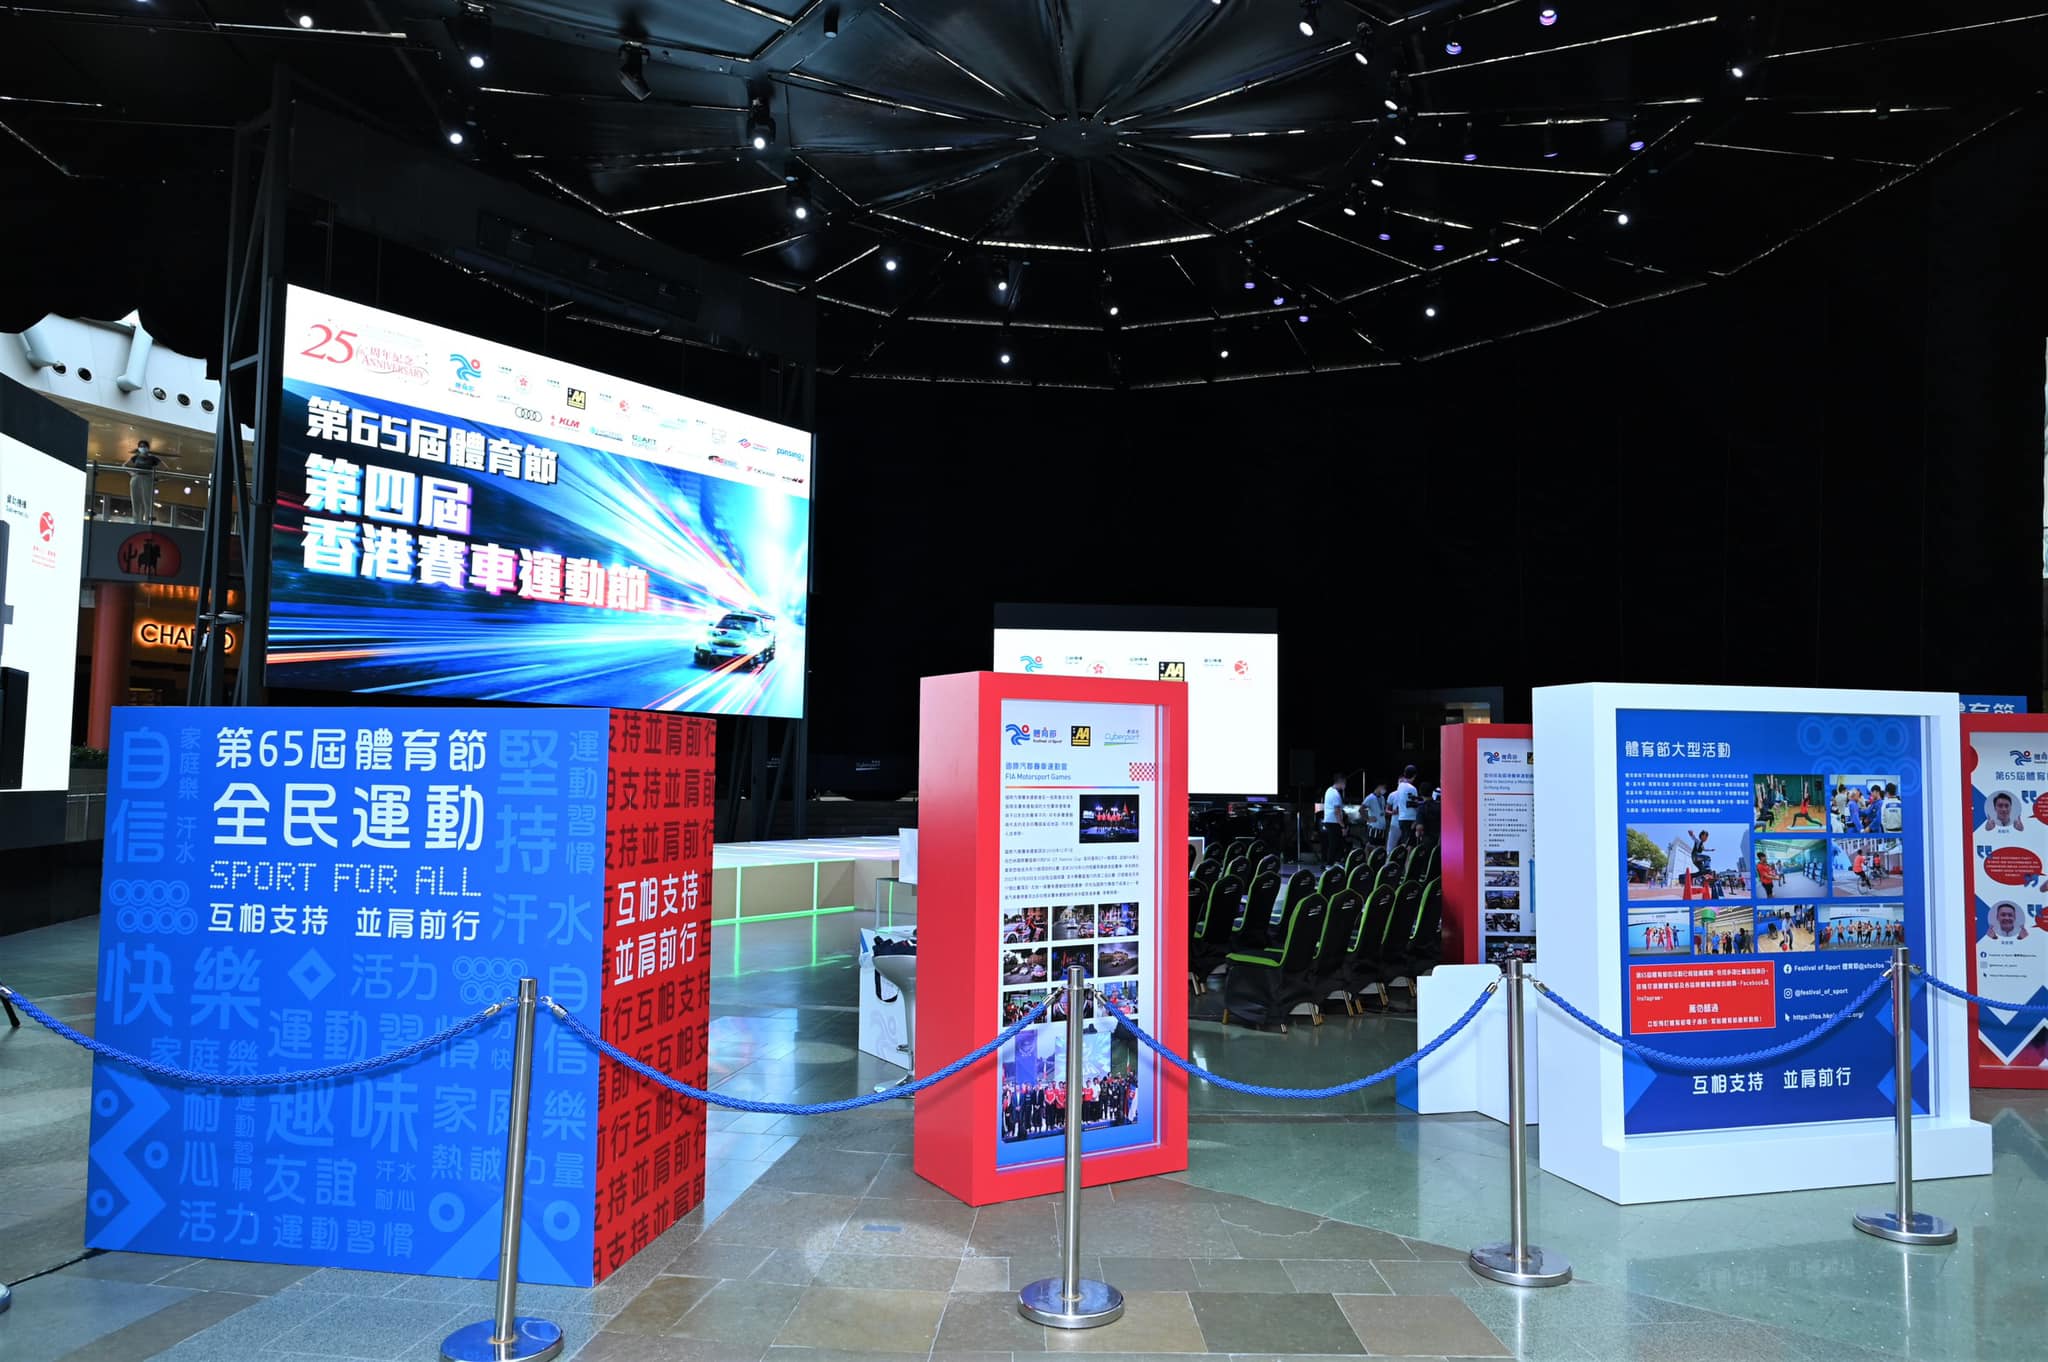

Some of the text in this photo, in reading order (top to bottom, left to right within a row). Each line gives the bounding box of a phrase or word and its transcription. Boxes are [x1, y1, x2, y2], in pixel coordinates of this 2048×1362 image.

[300, 324, 358, 364] 25
[362, 354, 425, 379] ANNIVERSARY
[306, 396, 558, 485] 第65屆體育節
[303, 453, 471, 534] 第四屆
[301, 515, 648, 610] 香港賽車運動節
[177, 727, 201, 800] 家庭樂
[215, 726, 488, 772] 第65屆體育節
[1625, 740, 1732, 759] 體育節大型活動
[111, 726, 171, 863] 自信
[1017, 773, 1050, 781] Motorsport
[213, 782, 485, 851] 全民運動
[495, 729, 559, 875] 堅持
[566, 730, 599, 875] 運動習慣
[175, 816, 198, 864] 汗水
[209, 860, 482, 897] SPORT FOR ALL
[615, 869, 698, 927] 互相支持
[207, 902, 480, 942] 互相支持 並肩前行
[491, 892, 593, 945] 汗水
[351, 952, 437, 1001] 活力
[614, 921, 698, 986] 並肩前行
[103, 942, 261, 1030] 快樂
[1691, 1066, 1852, 1095] 互相支持 並肩前行
[264, 1154, 358, 1207] 友誼
[375, 1159, 417, 1183] 汗水
[178, 1200, 260, 1245] 活力
[374, 1188, 416, 1212] 耐心
[273, 1214, 415, 1258] 運動習慣
